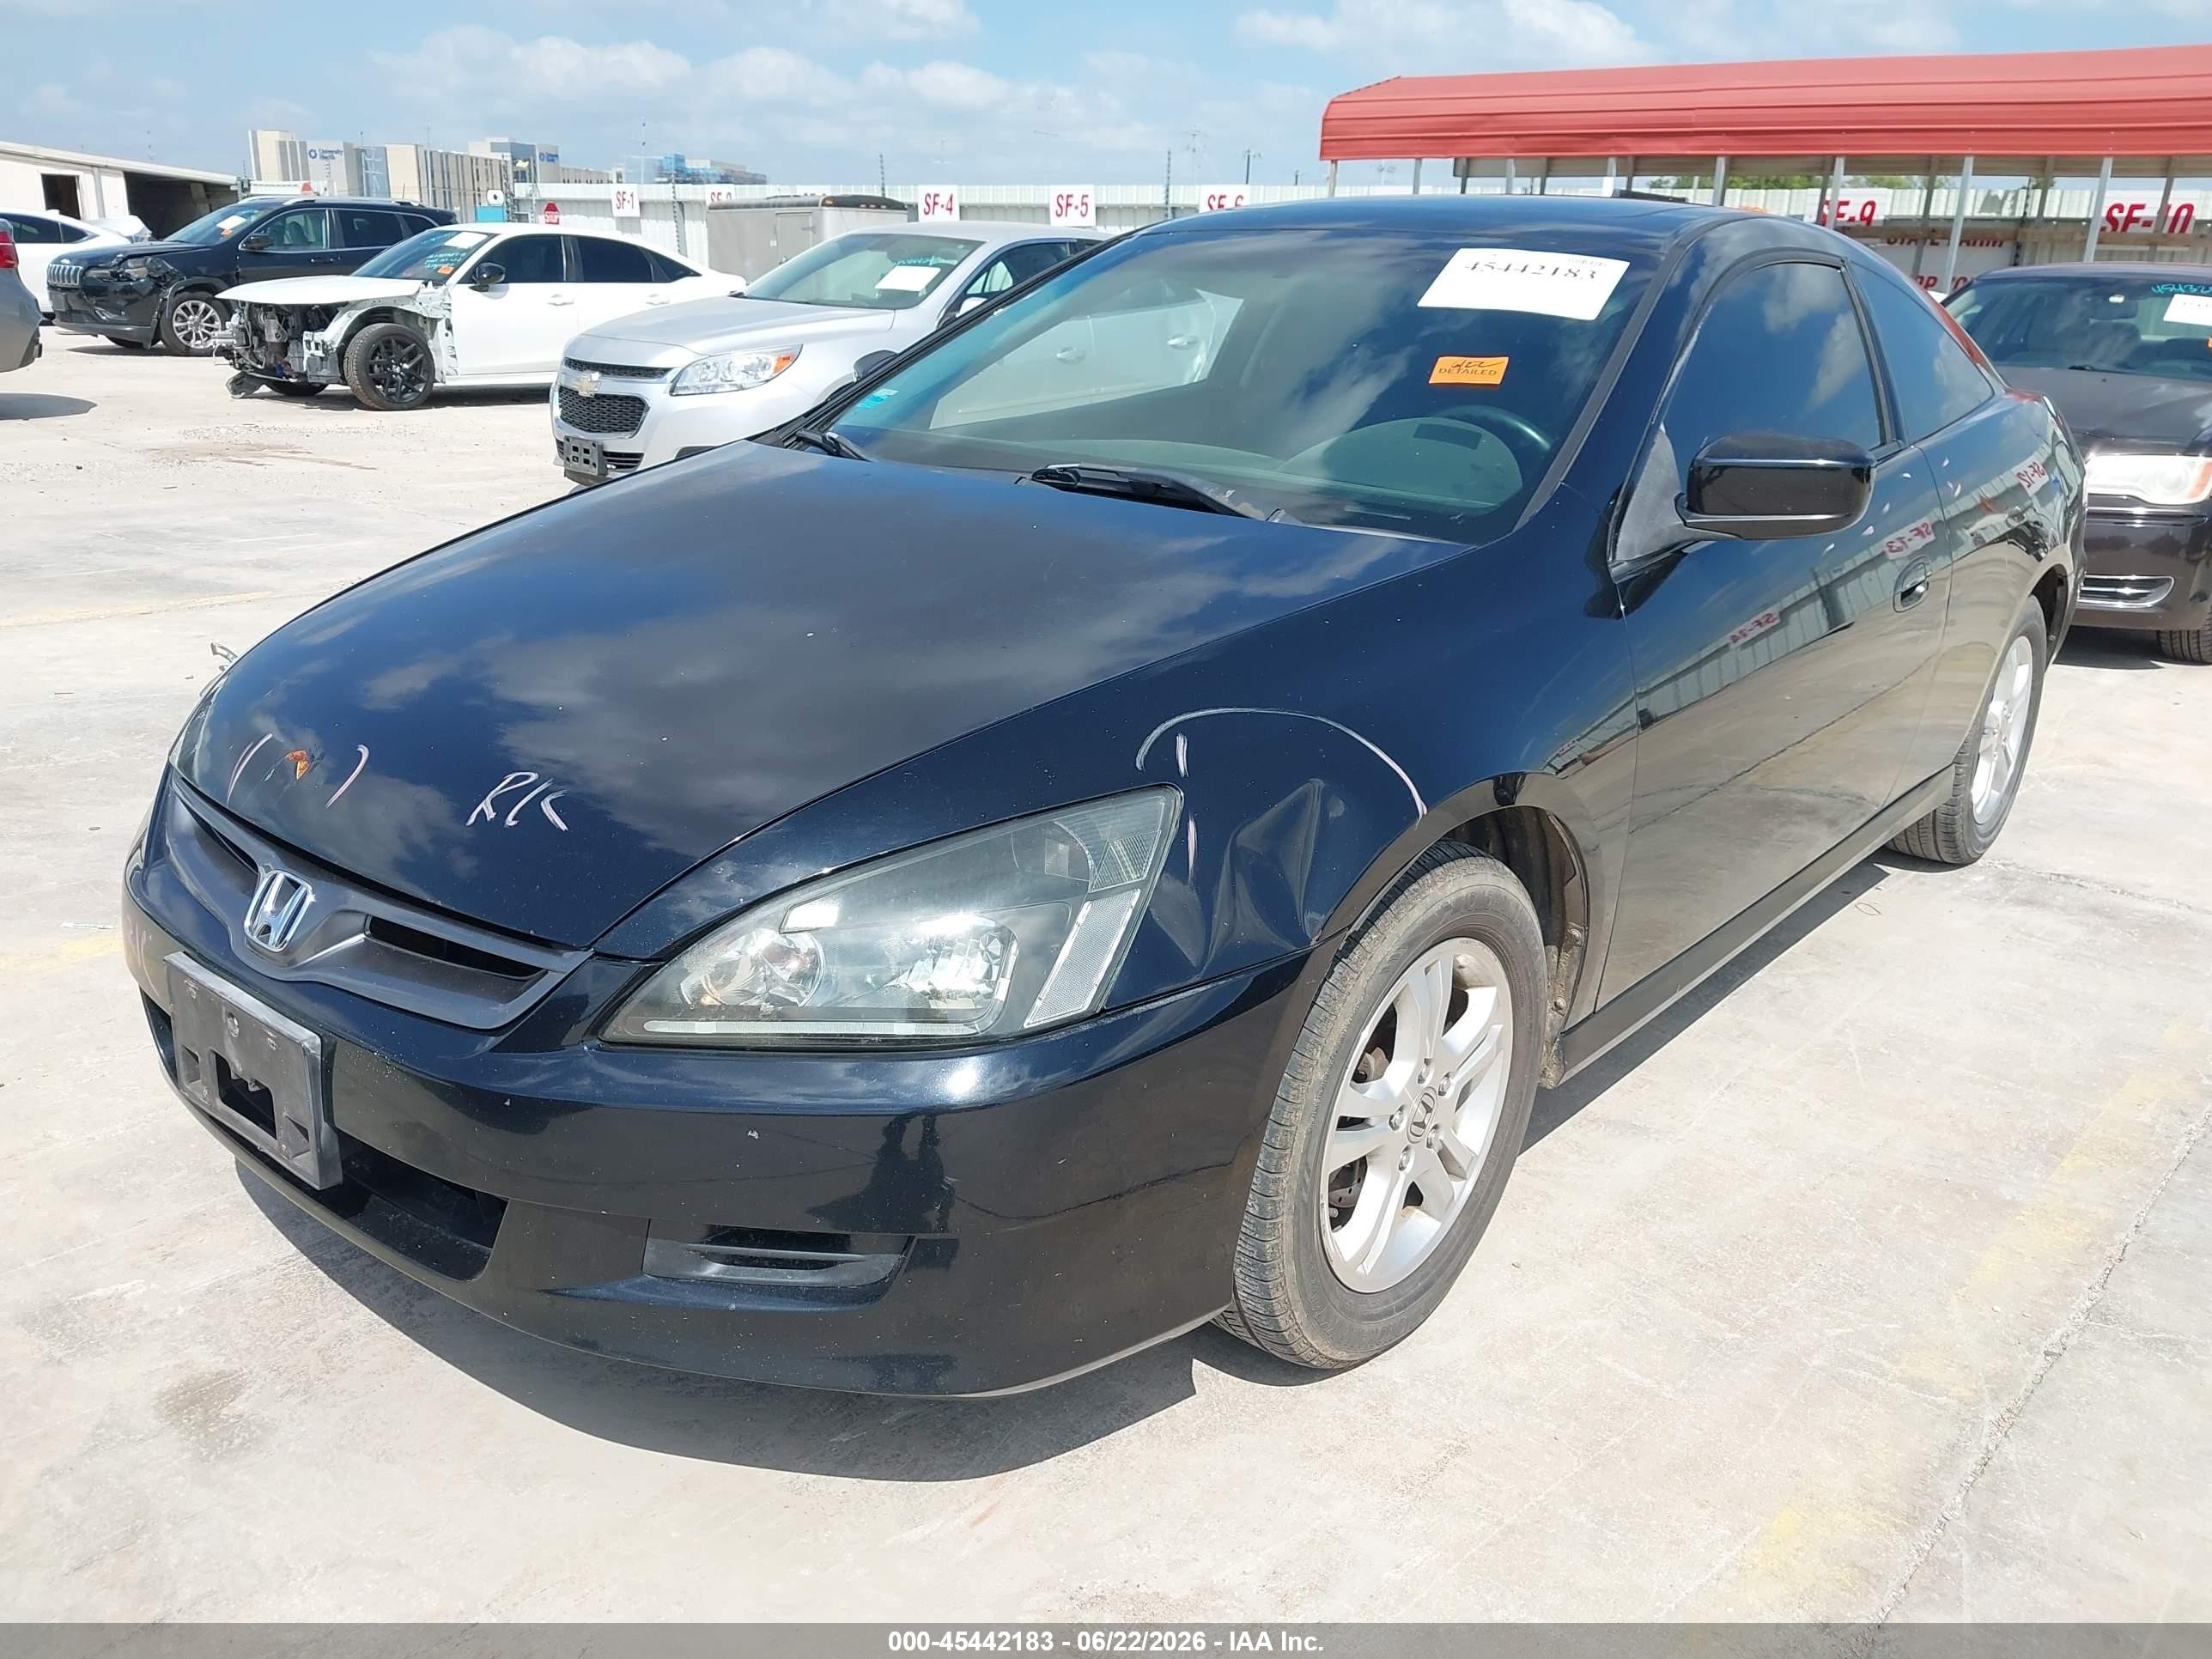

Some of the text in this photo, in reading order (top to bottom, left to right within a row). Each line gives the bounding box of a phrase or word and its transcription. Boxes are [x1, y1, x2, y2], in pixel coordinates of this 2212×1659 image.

[616, 191, 635, 210] SF-1
[923, 192, 954, 216] SF-4
[1055, 193, 1090, 218] SF-5
[1438, 367, 1498, 375] DETAILED
